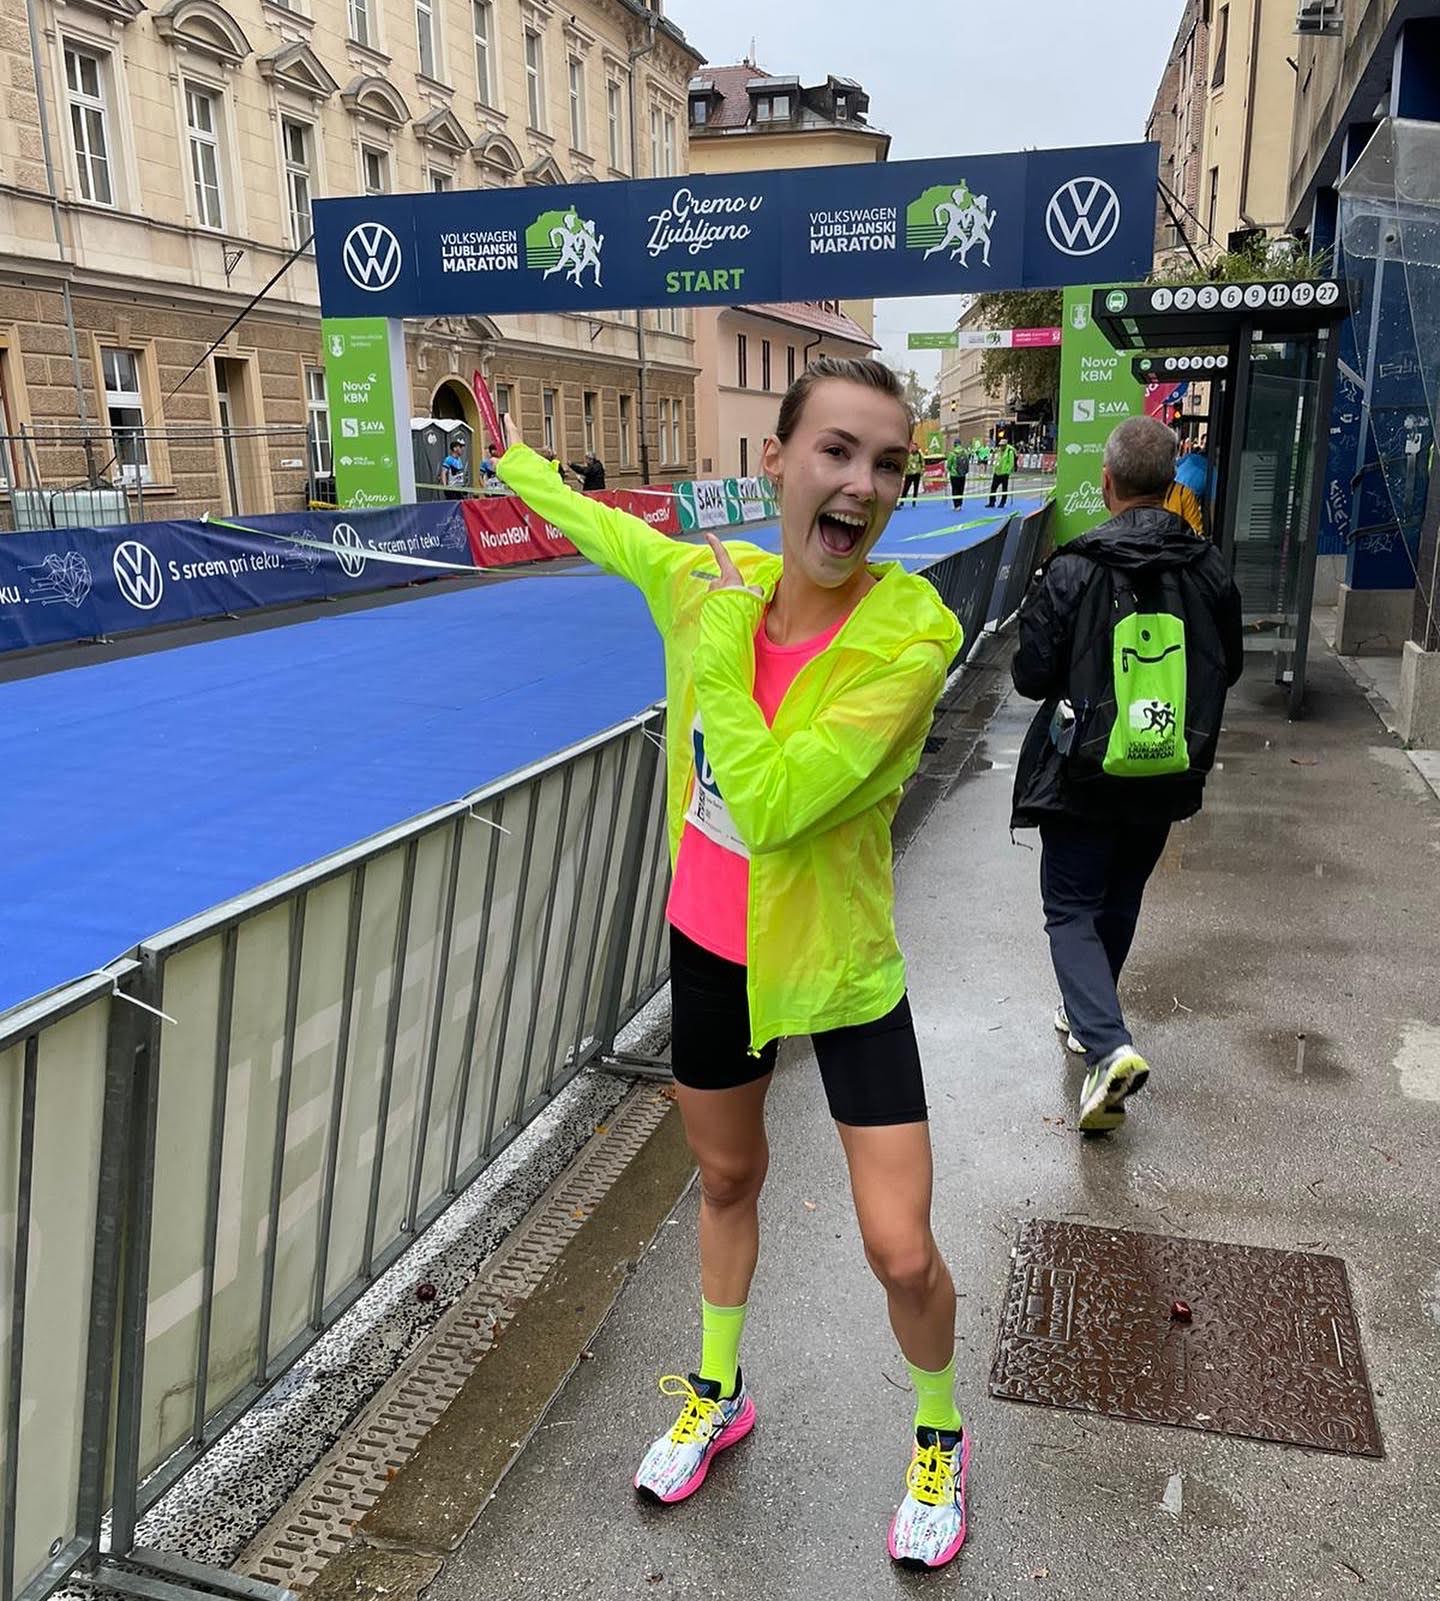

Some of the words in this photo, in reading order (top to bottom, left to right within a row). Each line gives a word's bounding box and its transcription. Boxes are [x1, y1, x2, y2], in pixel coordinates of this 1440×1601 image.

[672, 188, 748, 223] Gremo
[749, 196, 763, 211] v
[809, 208, 897, 224] VOLKSWAGEN
[440, 230, 517, 245] VOLKSWAGEN
[647, 209, 751, 257] Ljubljano
[810, 221, 897, 238] LJUBLJANSKI
[442, 243, 518, 258] LJUBLJANSKI
[810, 235, 896, 254] MARATON
[443, 255, 519, 273] MARATON
[666, 268, 745, 293] START
[1272, 288, 1286, 301] 11
[1295, 287, 1310, 300] 19
[1318, 287, 1336, 300] 27
[1081, 357, 1118, 368] Nova
[1081, 370, 1113, 382] KBM
[342, 380, 371, 392] Nova
[344, 392, 369, 404] KBM
[1098, 402, 1130, 413] SAVA
[360, 421, 385, 431] SAVA
[1080, 481, 1103, 500] Gre
[1064, 491, 1106, 516] Ljublja
[368, 540, 378, 552] S
[378, 540, 407, 553] srcem
[407, 534, 420, 555] pri
[420, 533, 444, 549] teku.
[168, 560, 181, 581] S
[182, 559, 229, 580] srcem
[229, 553, 249, 578] pri
[249, 551, 285, 572] teku.
